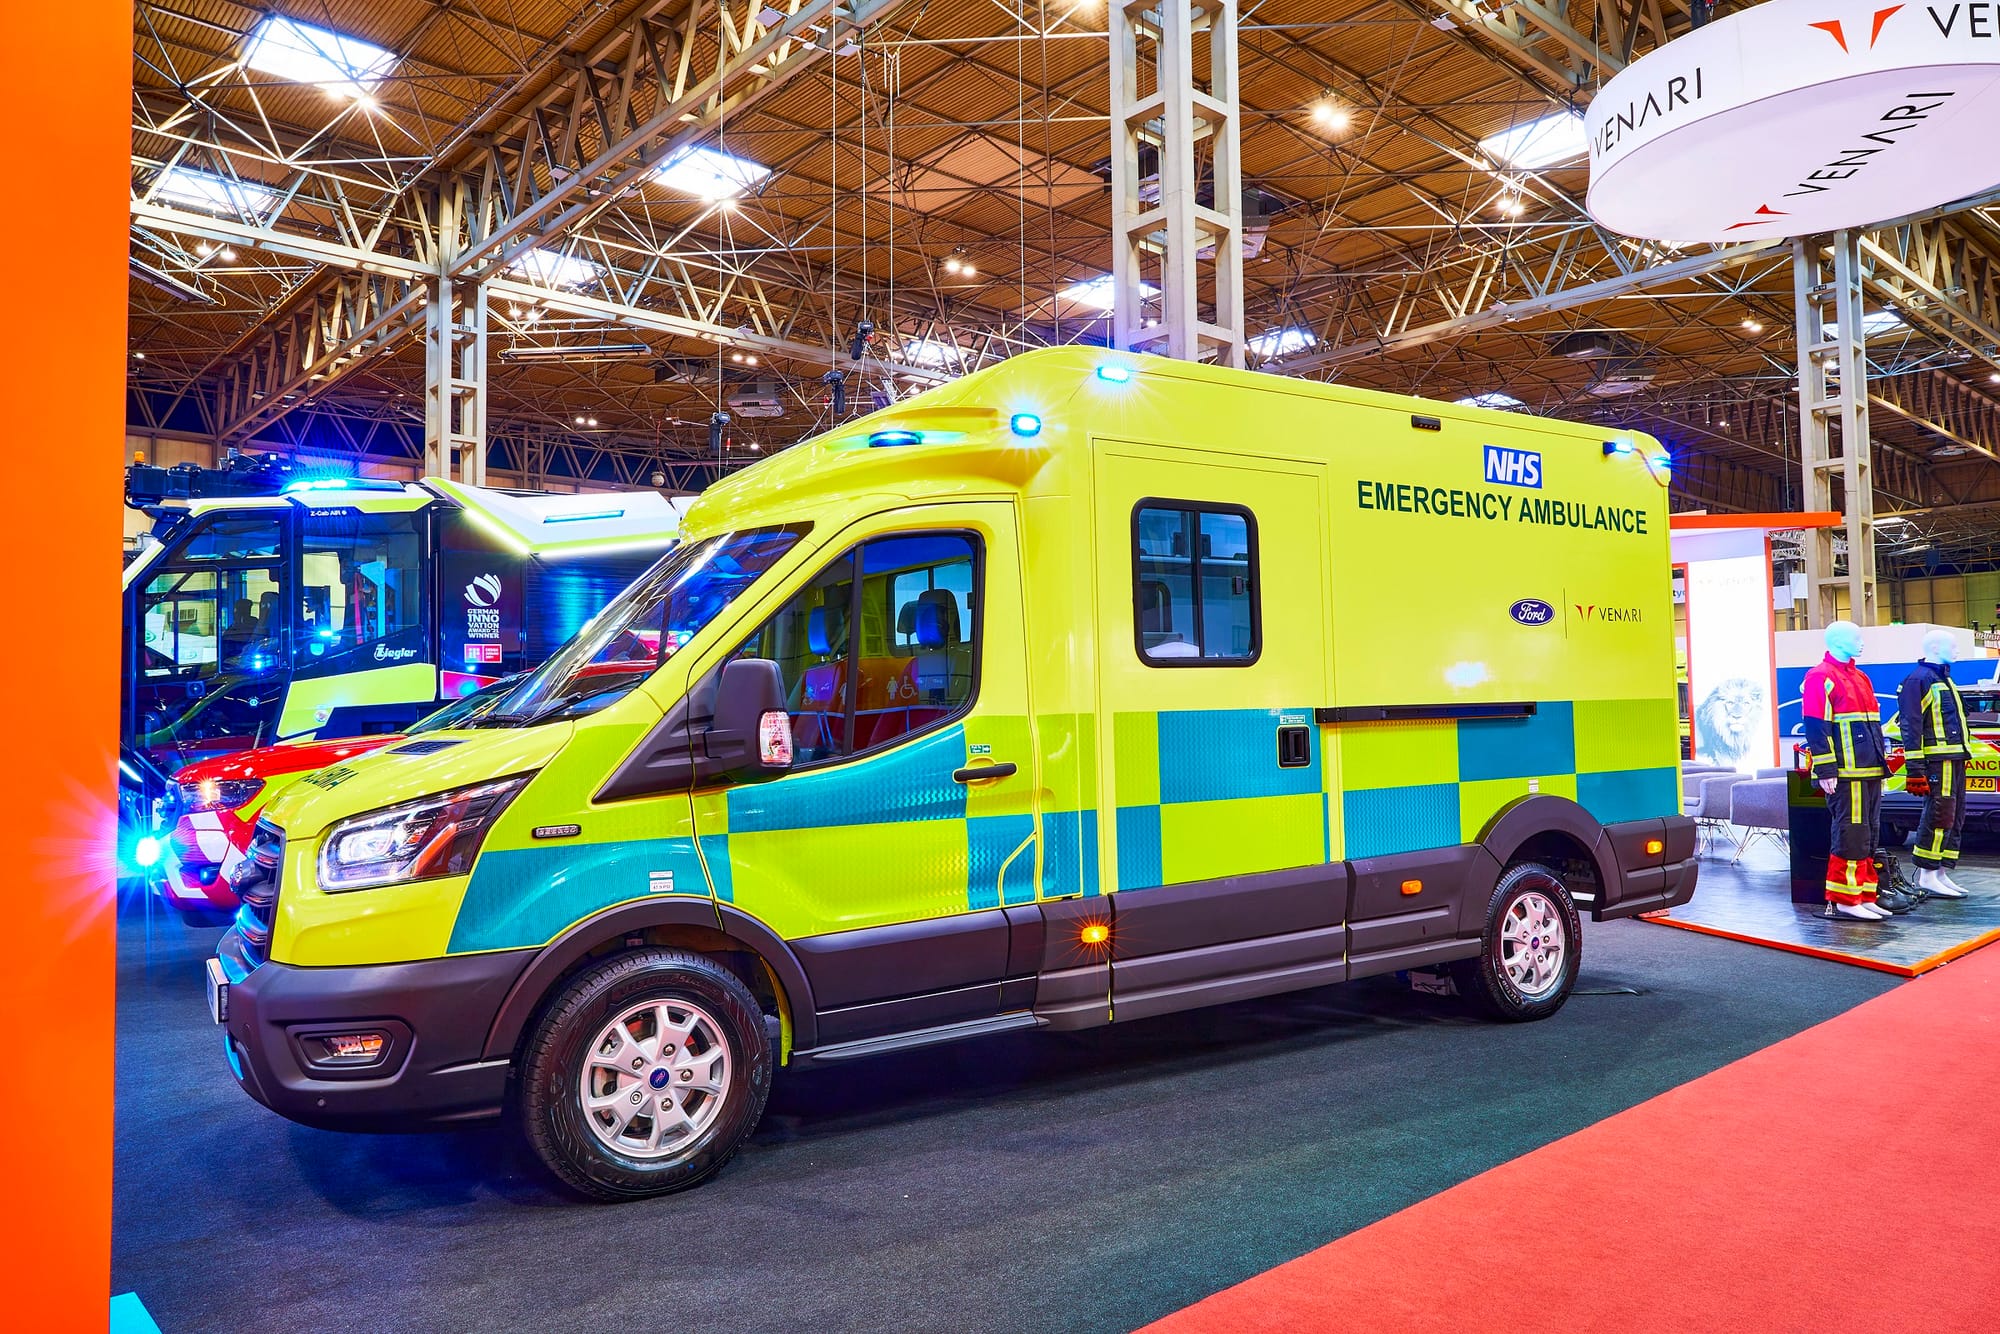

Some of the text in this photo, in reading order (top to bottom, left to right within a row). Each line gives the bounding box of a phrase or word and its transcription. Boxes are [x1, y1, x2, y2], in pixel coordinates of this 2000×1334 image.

[1926, 3, 2000, 39] VE
[1594, 67, 1702, 160] VENARI
[1782, 91, 1955, 197] VENARI
[1485, 448, 1540, 486] NHS
[1357, 480, 1648, 535] EMERGENCY AMBULANCE
[467, 614, 500, 623] INNO
[1518, 602, 1546, 622] Ford
[1599, 607, 1642, 623] VENARI
[1965, 760, 2000, 771] ANC
